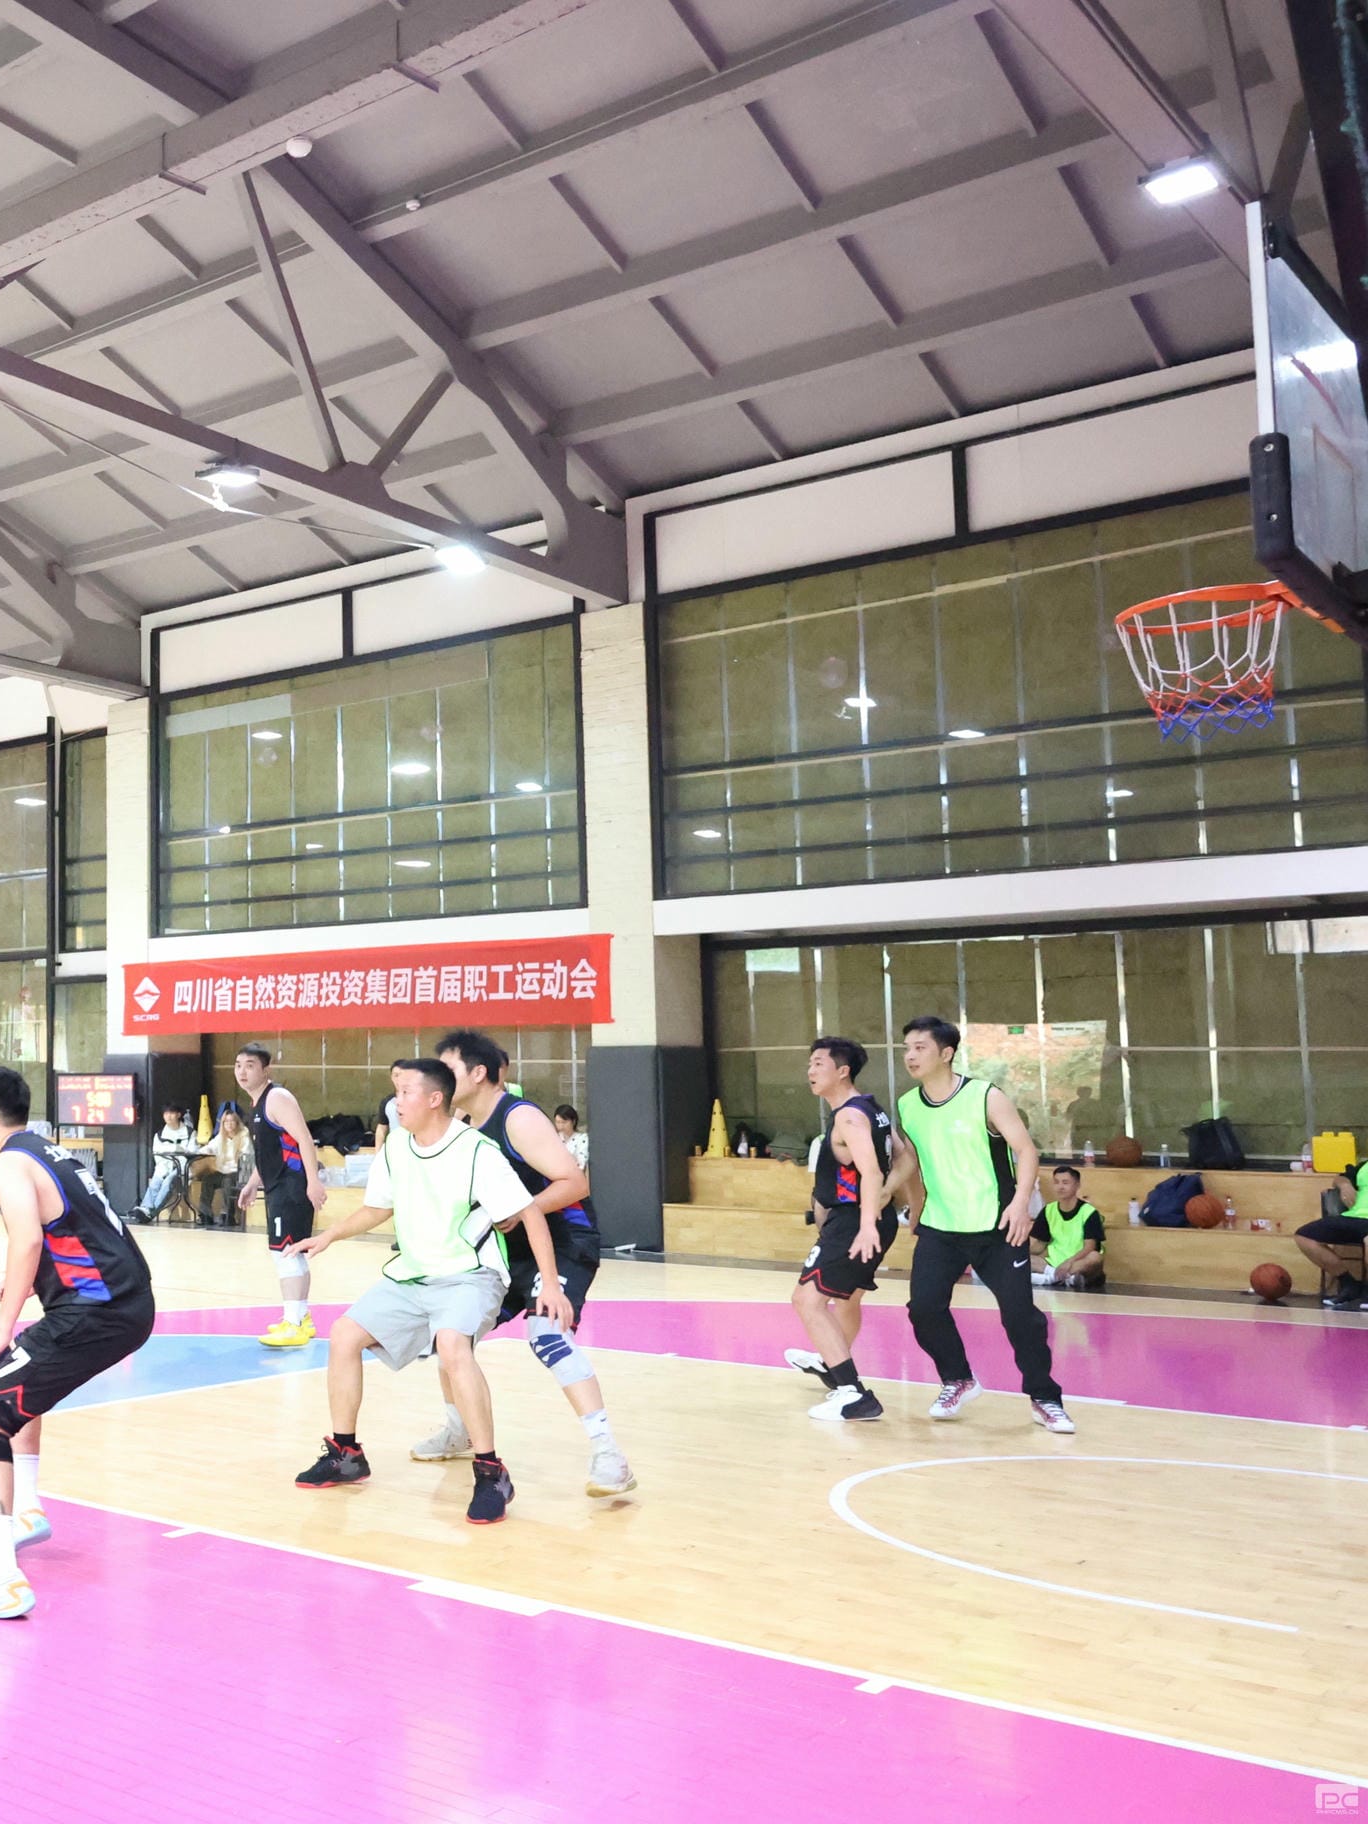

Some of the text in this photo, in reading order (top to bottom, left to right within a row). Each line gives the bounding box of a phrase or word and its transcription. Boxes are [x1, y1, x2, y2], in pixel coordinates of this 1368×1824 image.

[173, 958, 598, 1014] 四川省自然资源投资集团首届职工运动会
